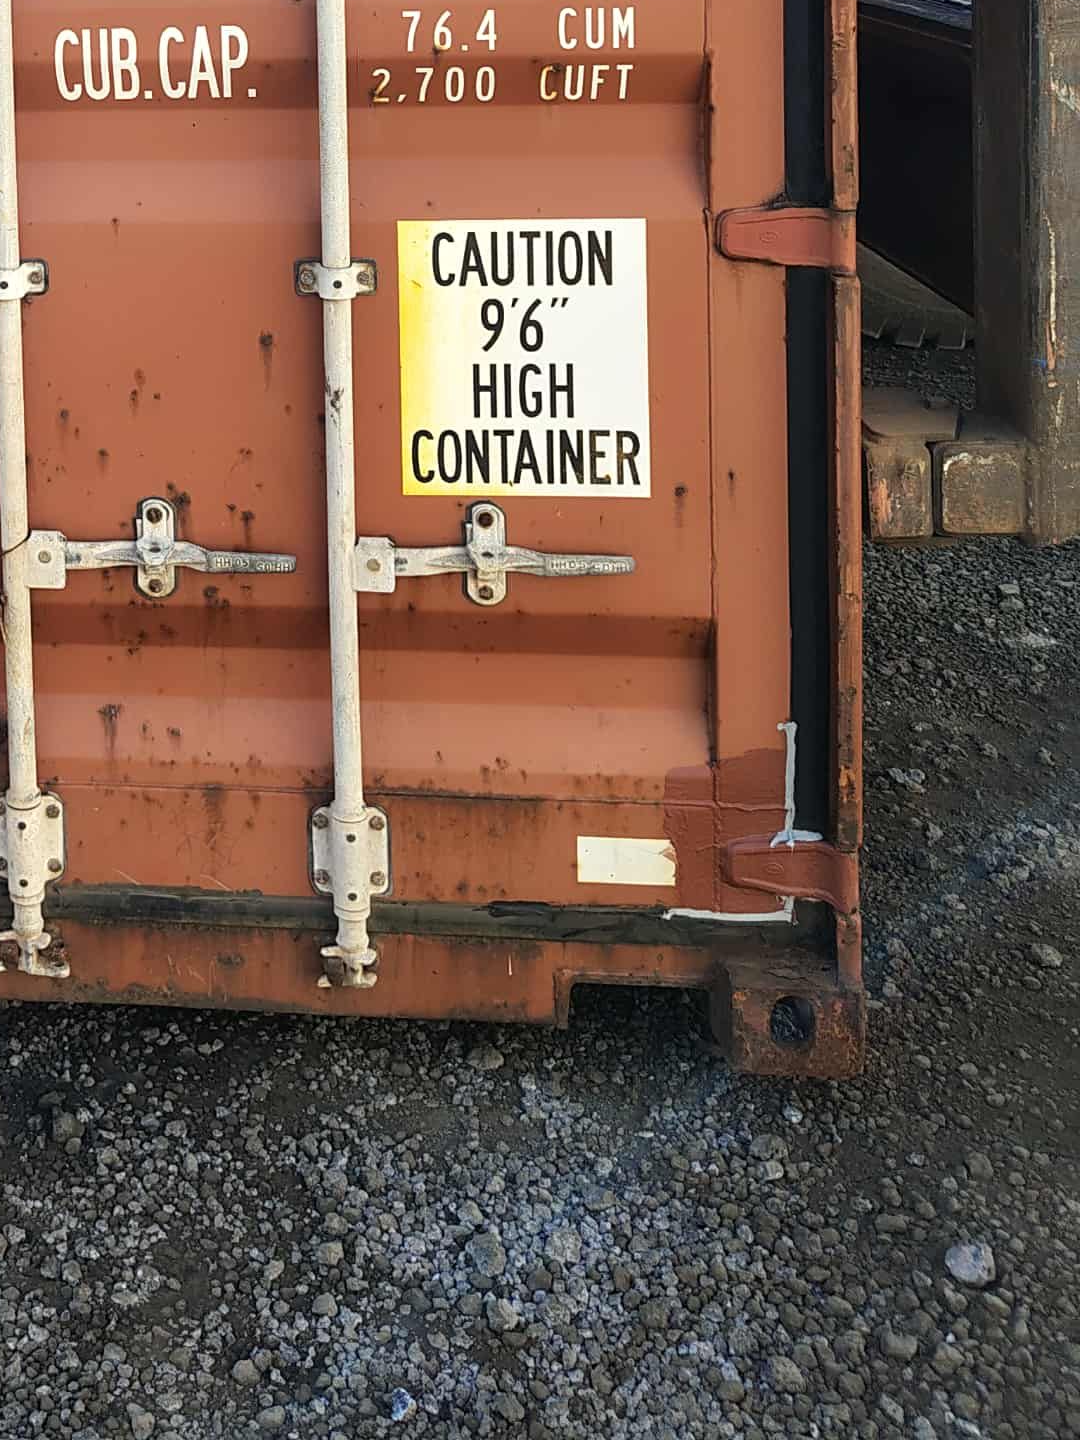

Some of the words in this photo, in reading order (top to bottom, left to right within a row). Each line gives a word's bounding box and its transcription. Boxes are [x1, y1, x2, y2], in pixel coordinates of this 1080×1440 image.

[54, 25, 257, 101] CUB.CAP.
[401, 9, 497, 53] 76.4
[558, 6, 635, 50] CUM
[372, 66, 495, 104] 2,700
[539, 63, 634, 101] CUFT
[431, 230, 613, 287] CAUTION
[472, 363, 575, 419] HIGH
[411, 429, 641, 485] CONTAINER
